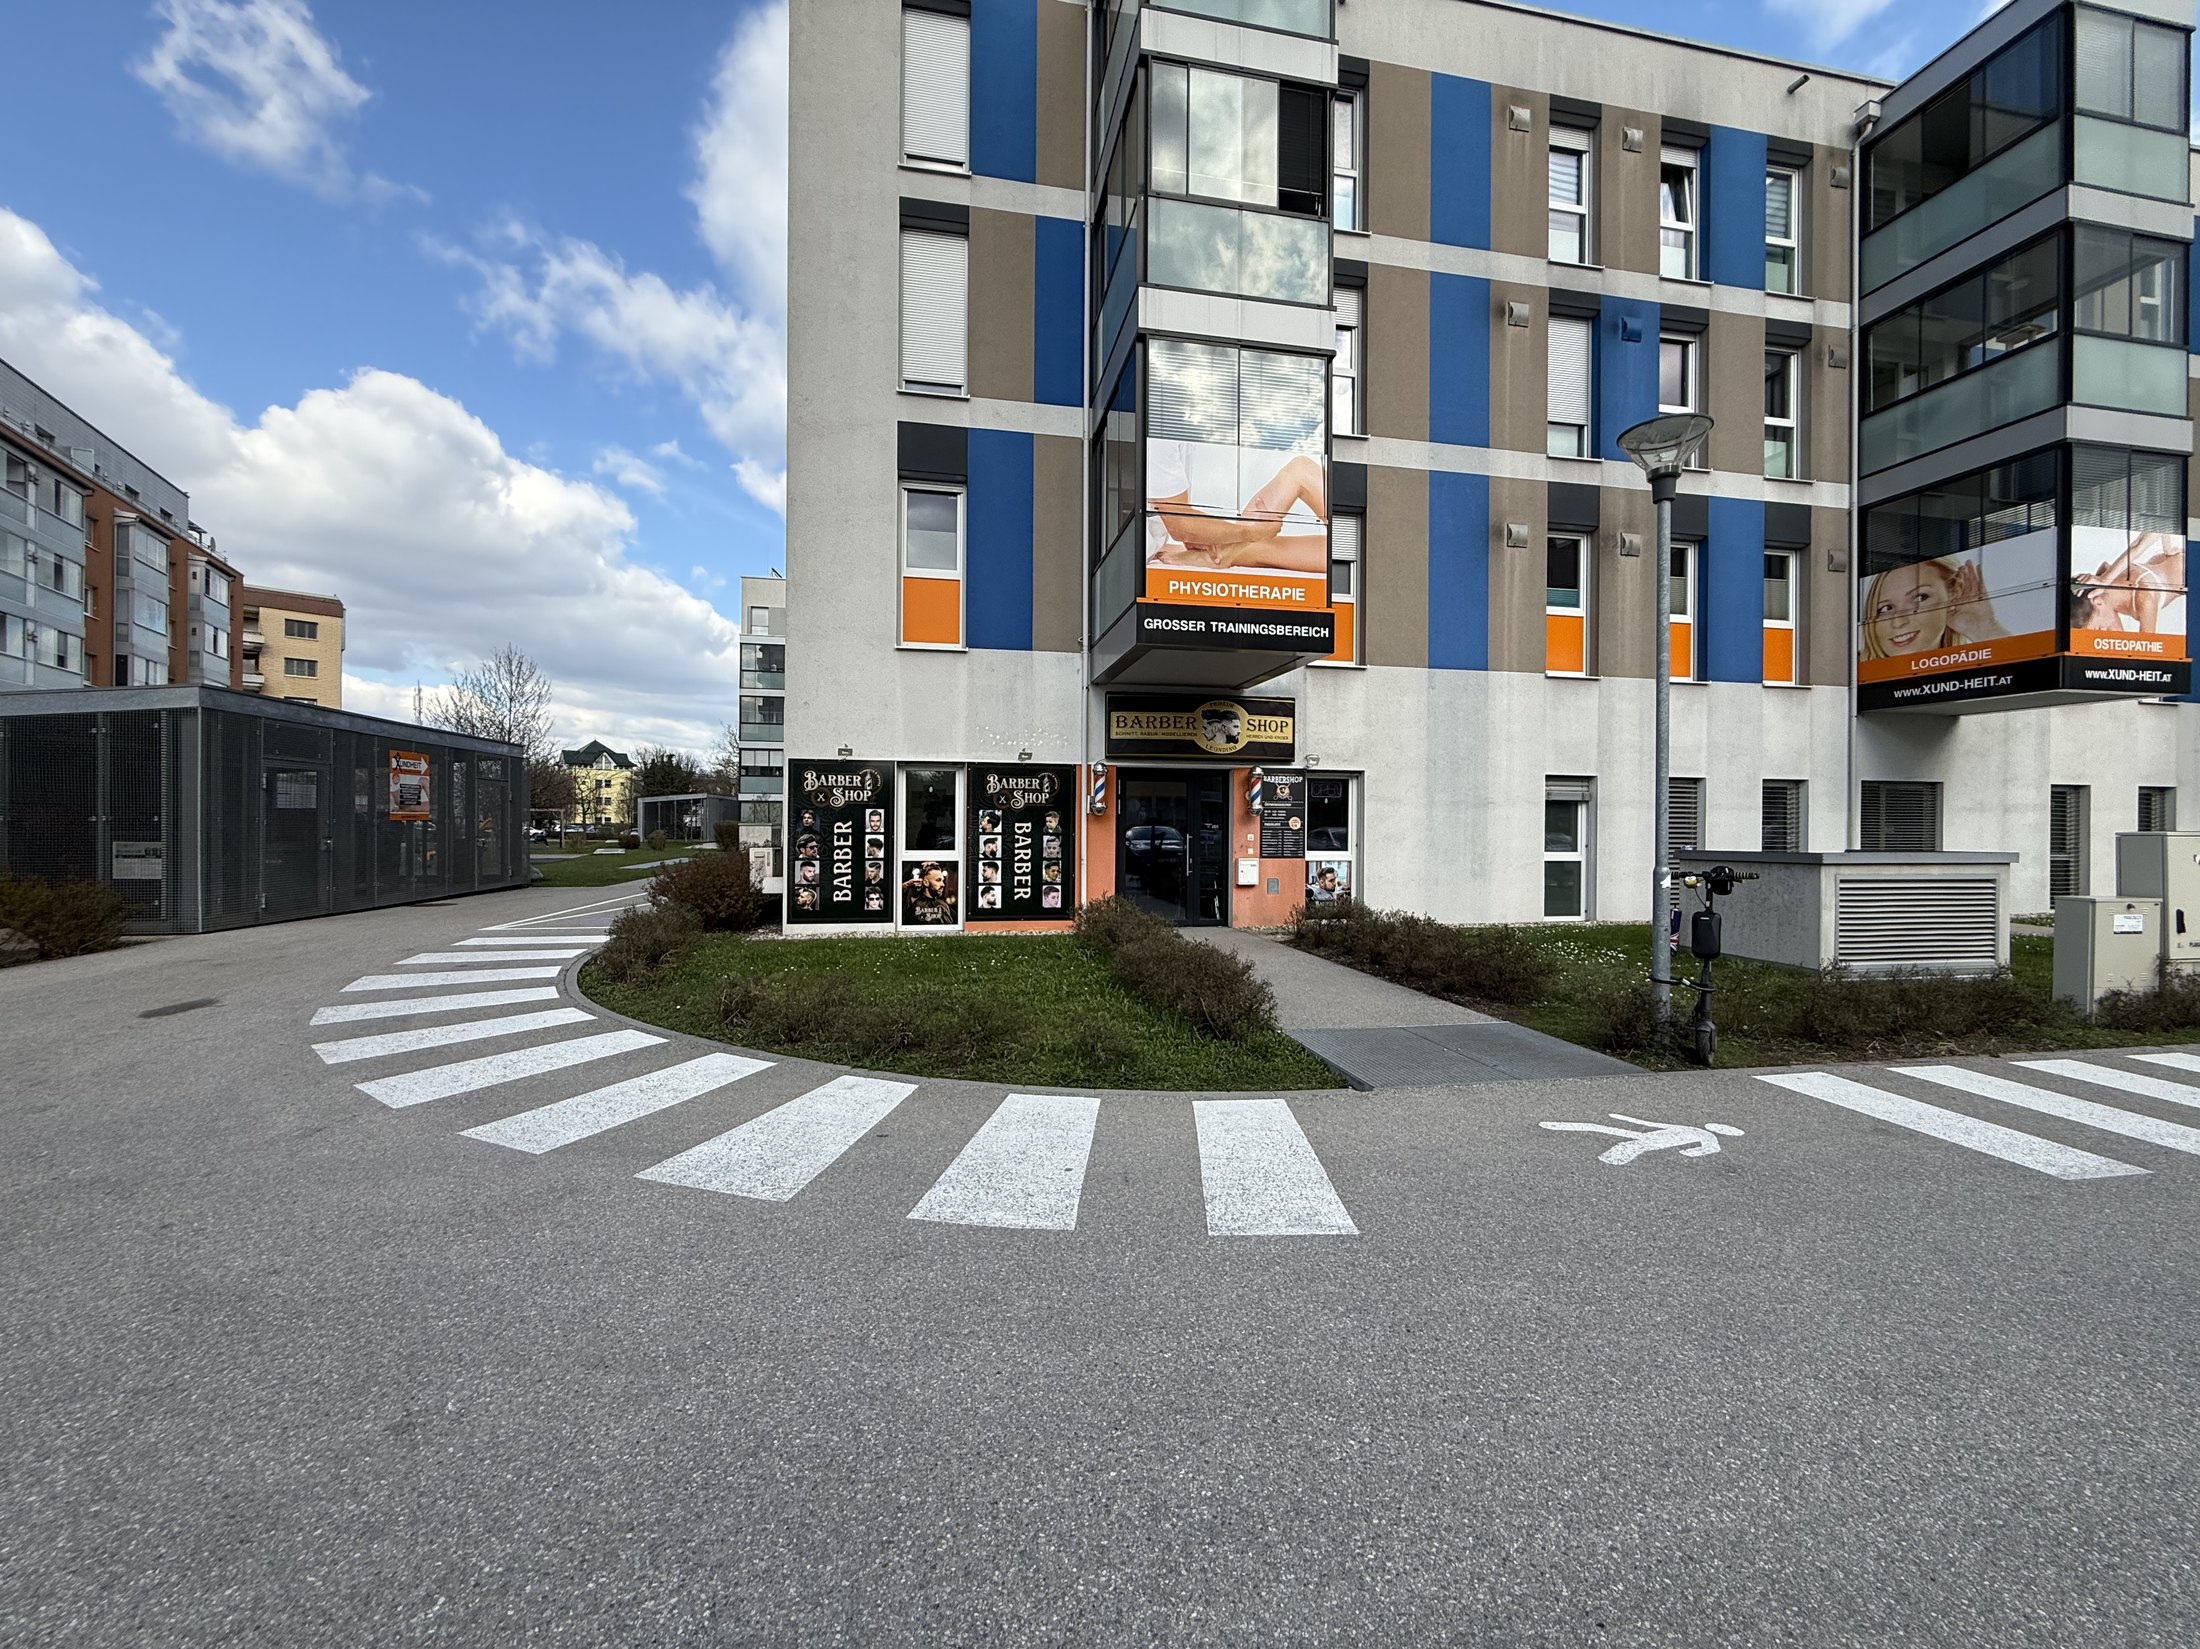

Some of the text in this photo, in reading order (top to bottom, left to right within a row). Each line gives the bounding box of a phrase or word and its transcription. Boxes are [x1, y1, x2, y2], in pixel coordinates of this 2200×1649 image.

[1168, 580, 1306, 602] PHYSIOTHERAPIE
[1143, 618, 1330, 638] GROSSER TRAININGSBEREICH
[2093, 637, 2164, 653] OSTEOPATHIE
[1911, 648, 1993, 671] LOGOPÄDIE
[1115, 715, 1289, 733] BARBER SHOP
[1205, 744, 1238, 753] LEONDING
[803, 770, 862, 792] BARBER
[986, 773, 1041, 794] BARBER
[1263, 775, 1304, 784] BARBERSHOP
[829, 786, 872, 807] SHOP
[1010, 789, 1050, 809] SHOP
[833, 820, 853, 902] BARBER
[1014, 822, 1032, 900] BARBER
